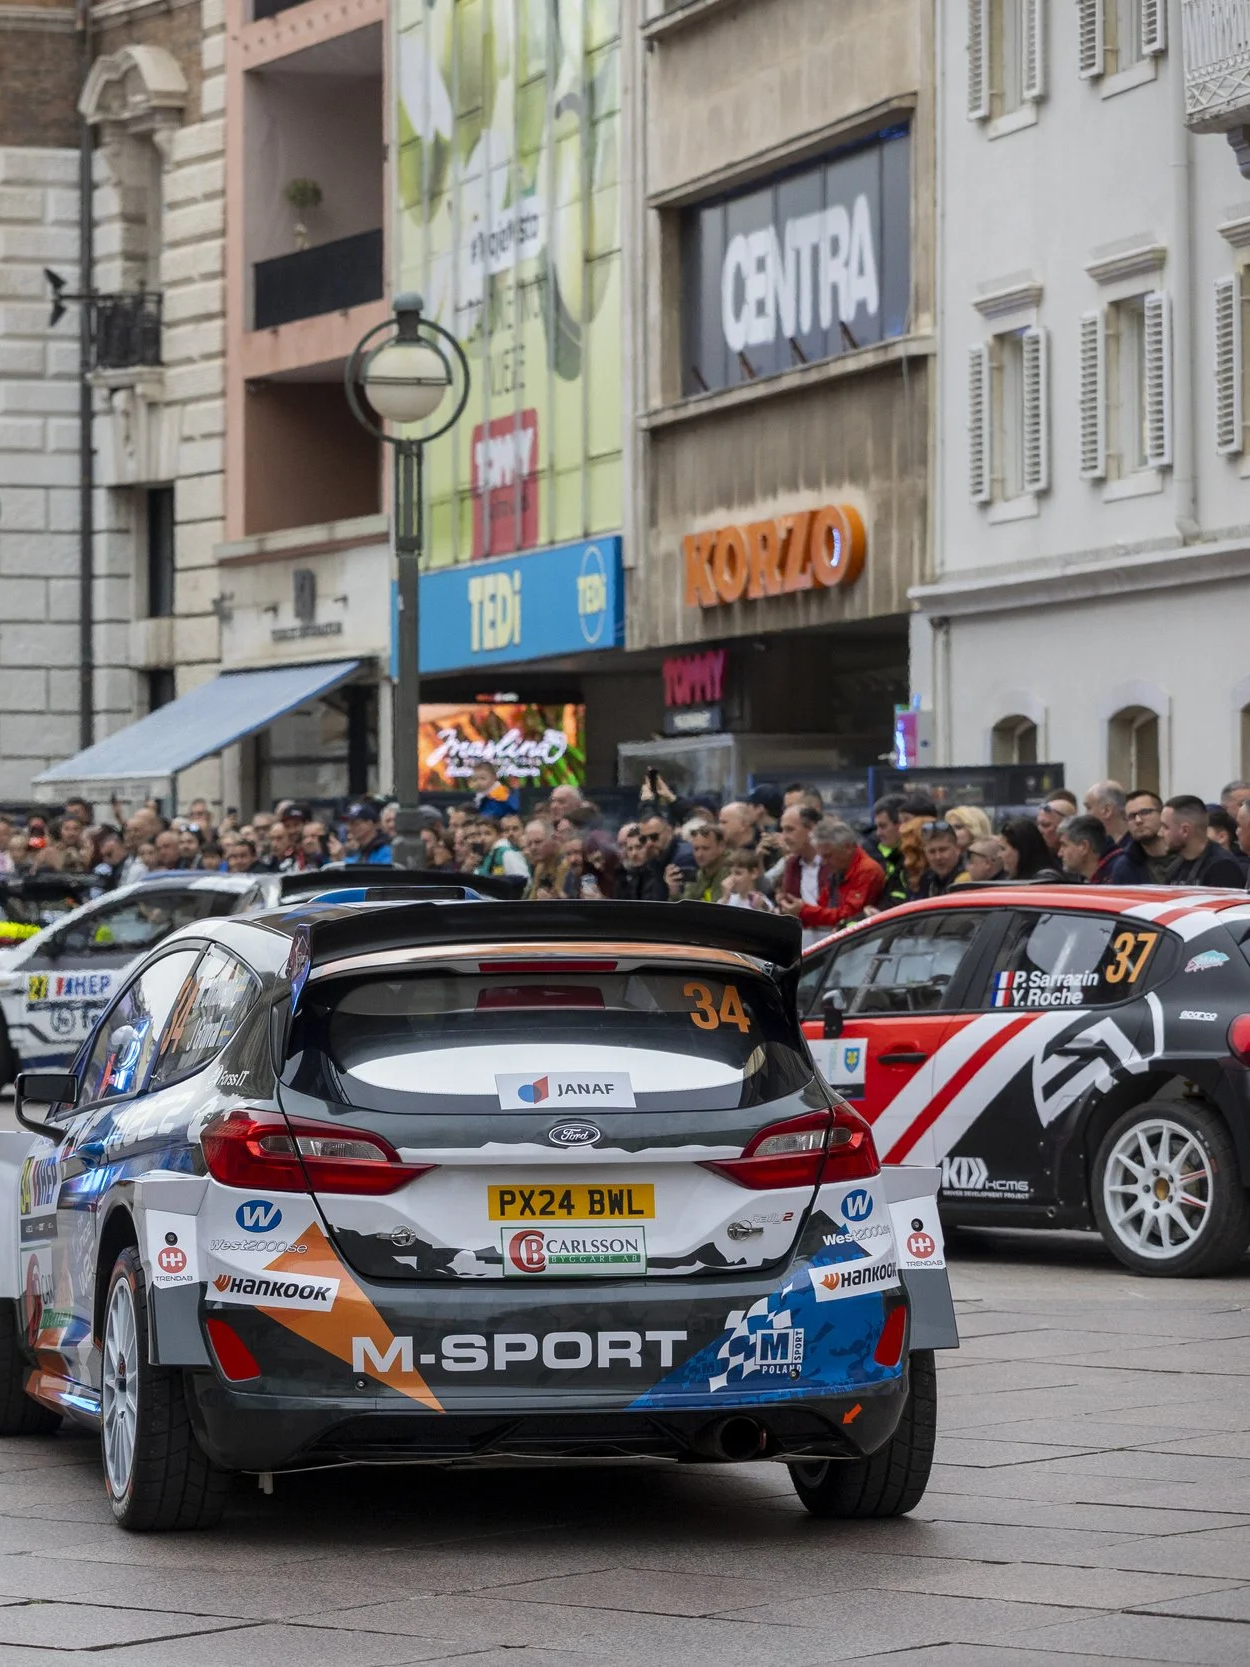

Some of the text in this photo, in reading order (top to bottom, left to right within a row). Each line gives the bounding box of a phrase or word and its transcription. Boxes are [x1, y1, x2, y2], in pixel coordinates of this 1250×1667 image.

[722, 194, 879, 352] CENTRA
[683, 504, 862, 607] KORZO
[469, 570, 521, 652] TEDi
[1106, 932, 1158, 984] 37
[75, 975, 112, 995] HEP
[683, 982, 750, 1033] 34
[235, 1070, 250, 1086] IT
[557, 1083, 614, 1097] JANAF
[560, 1128, 589, 1142] Ford
[499, 1189, 644, 1216] PX24 BWL
[546, 1238, 638, 1254] CARLSSON
[551, 1254, 638, 1263] BYGGARE AB
[230, 1278, 332, 1302] HANKOOK
[352, 1331, 687, 1373] M-SPORT
[793, 1329, 803, 1361] SPORT
[762, 1364, 802, 1375] POLAND
